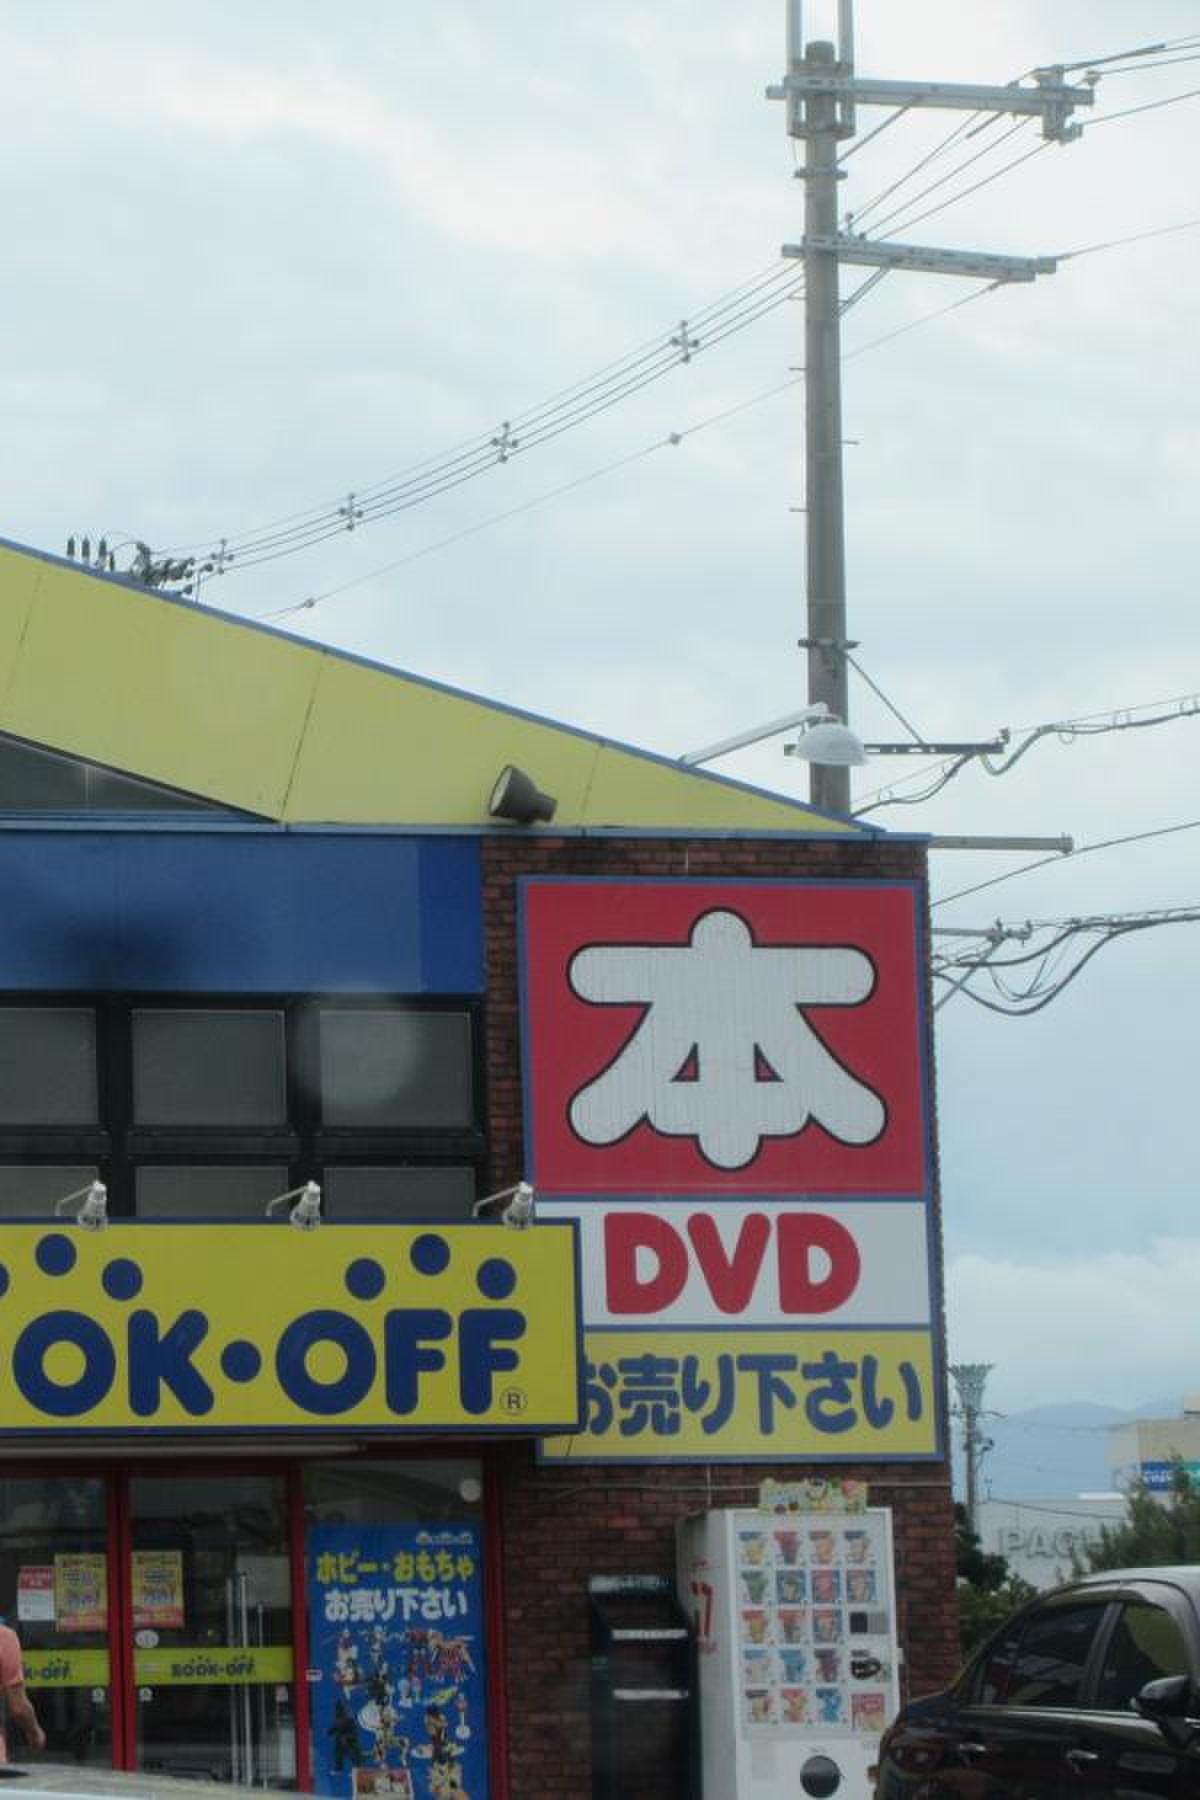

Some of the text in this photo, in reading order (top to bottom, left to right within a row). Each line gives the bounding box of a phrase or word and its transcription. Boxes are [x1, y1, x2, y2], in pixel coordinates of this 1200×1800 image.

[567, 906, 888, 1173] 本
[604, 1212, 861, 1314] DVD
[324, 1587, 469, 1622] お売り下さい
